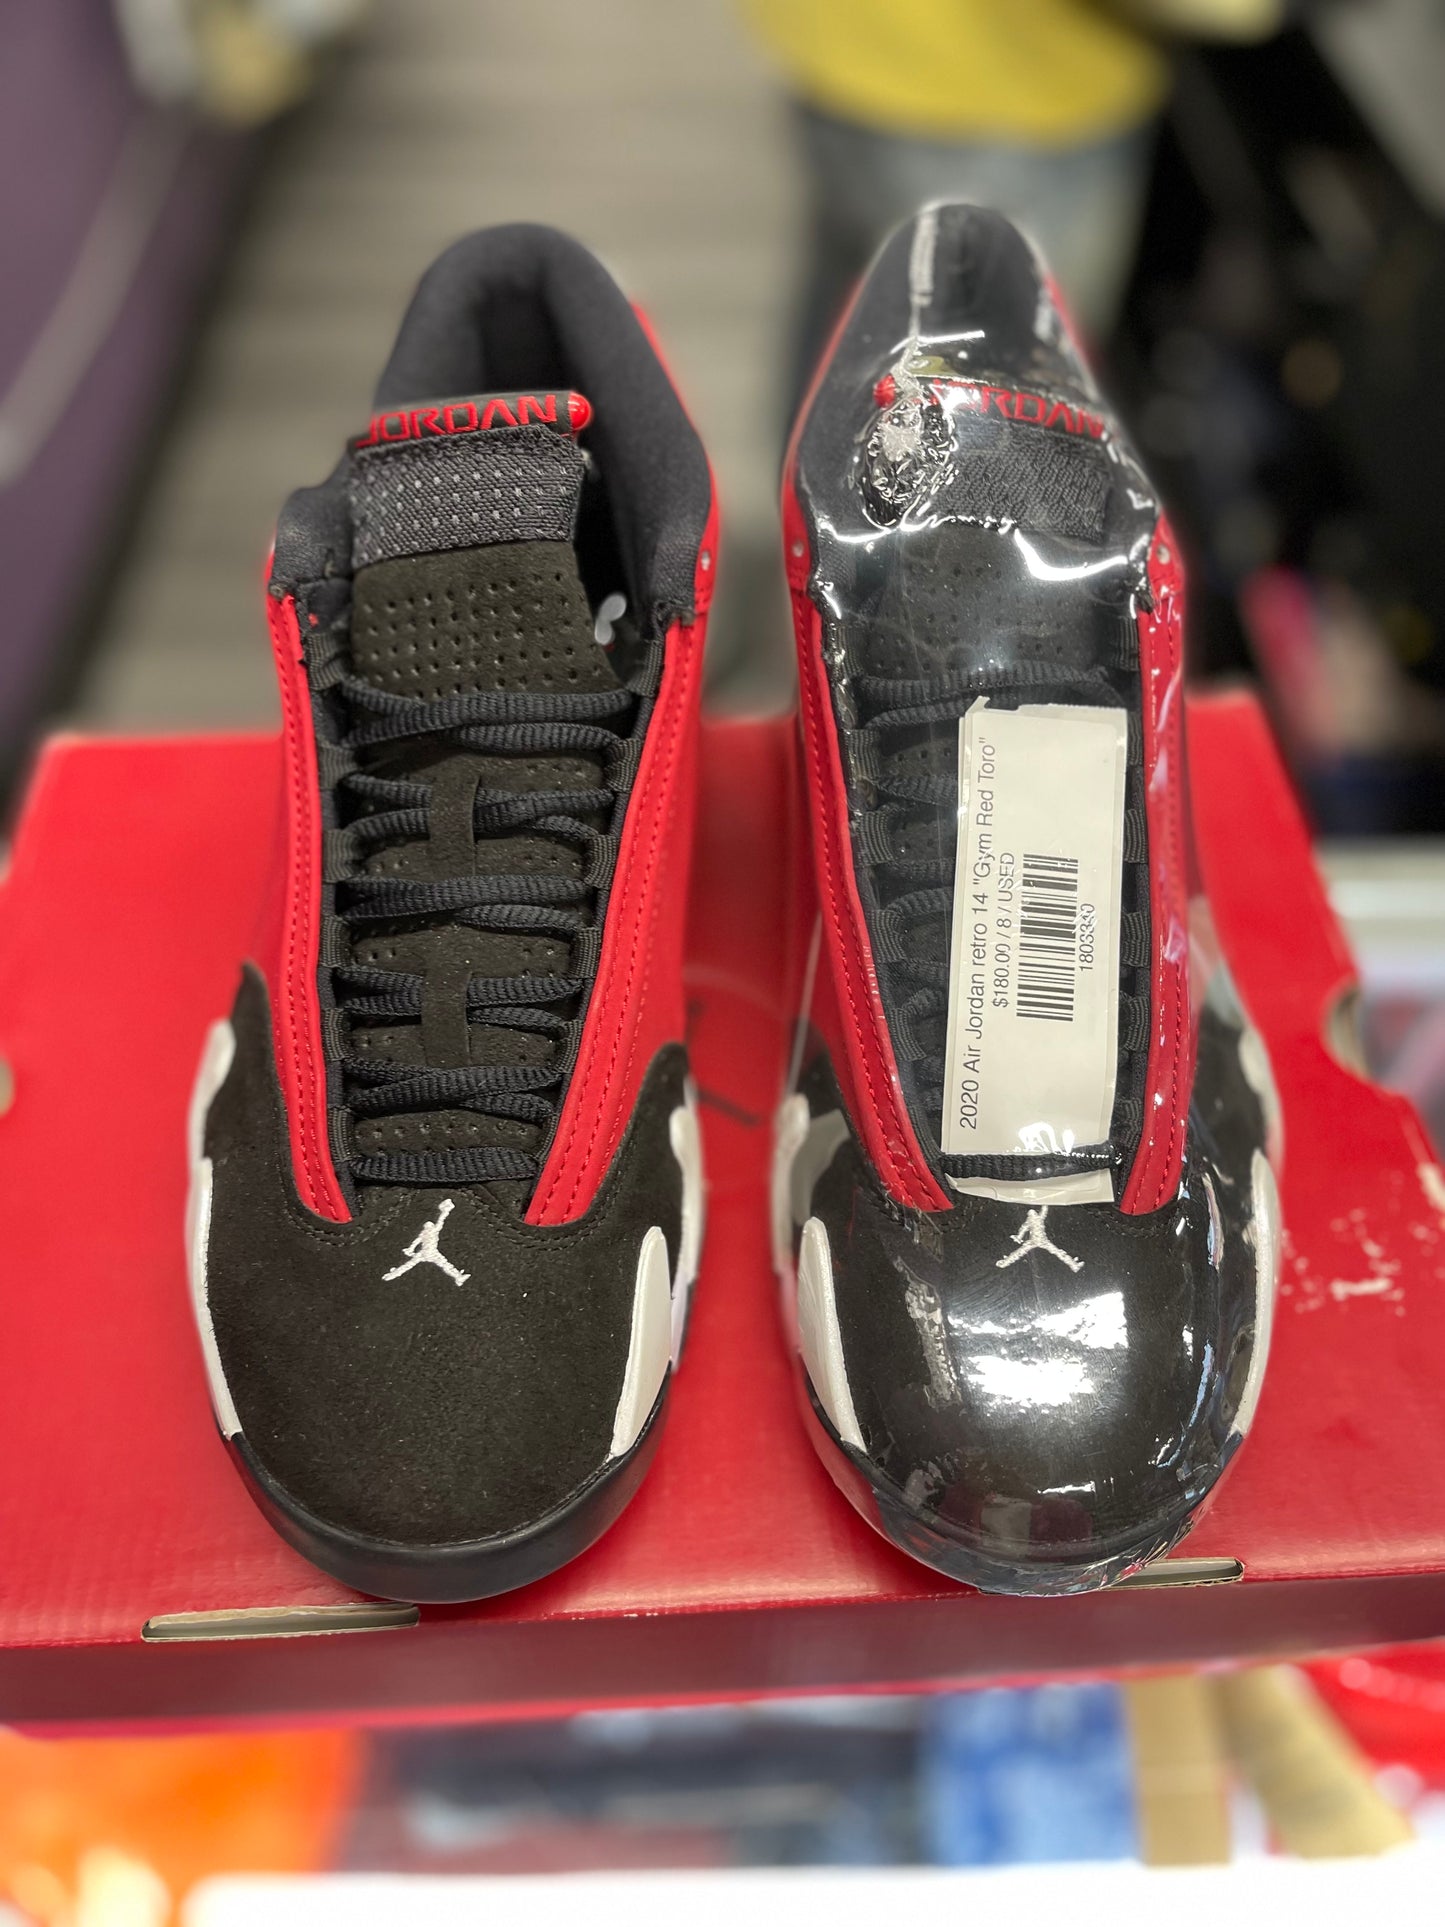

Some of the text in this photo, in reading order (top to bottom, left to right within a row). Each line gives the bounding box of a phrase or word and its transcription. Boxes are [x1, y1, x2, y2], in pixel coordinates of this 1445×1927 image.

[355, 394, 557, 448] JORDAN
[998, 852, 1015, 902] USED
[959, 736, 996, 1130] 2020 Air Jordan retro 14 "Gym Red Toro"
[997, 918, 1012, 929] 8
[991, 943, 1011, 1008] $180.00
